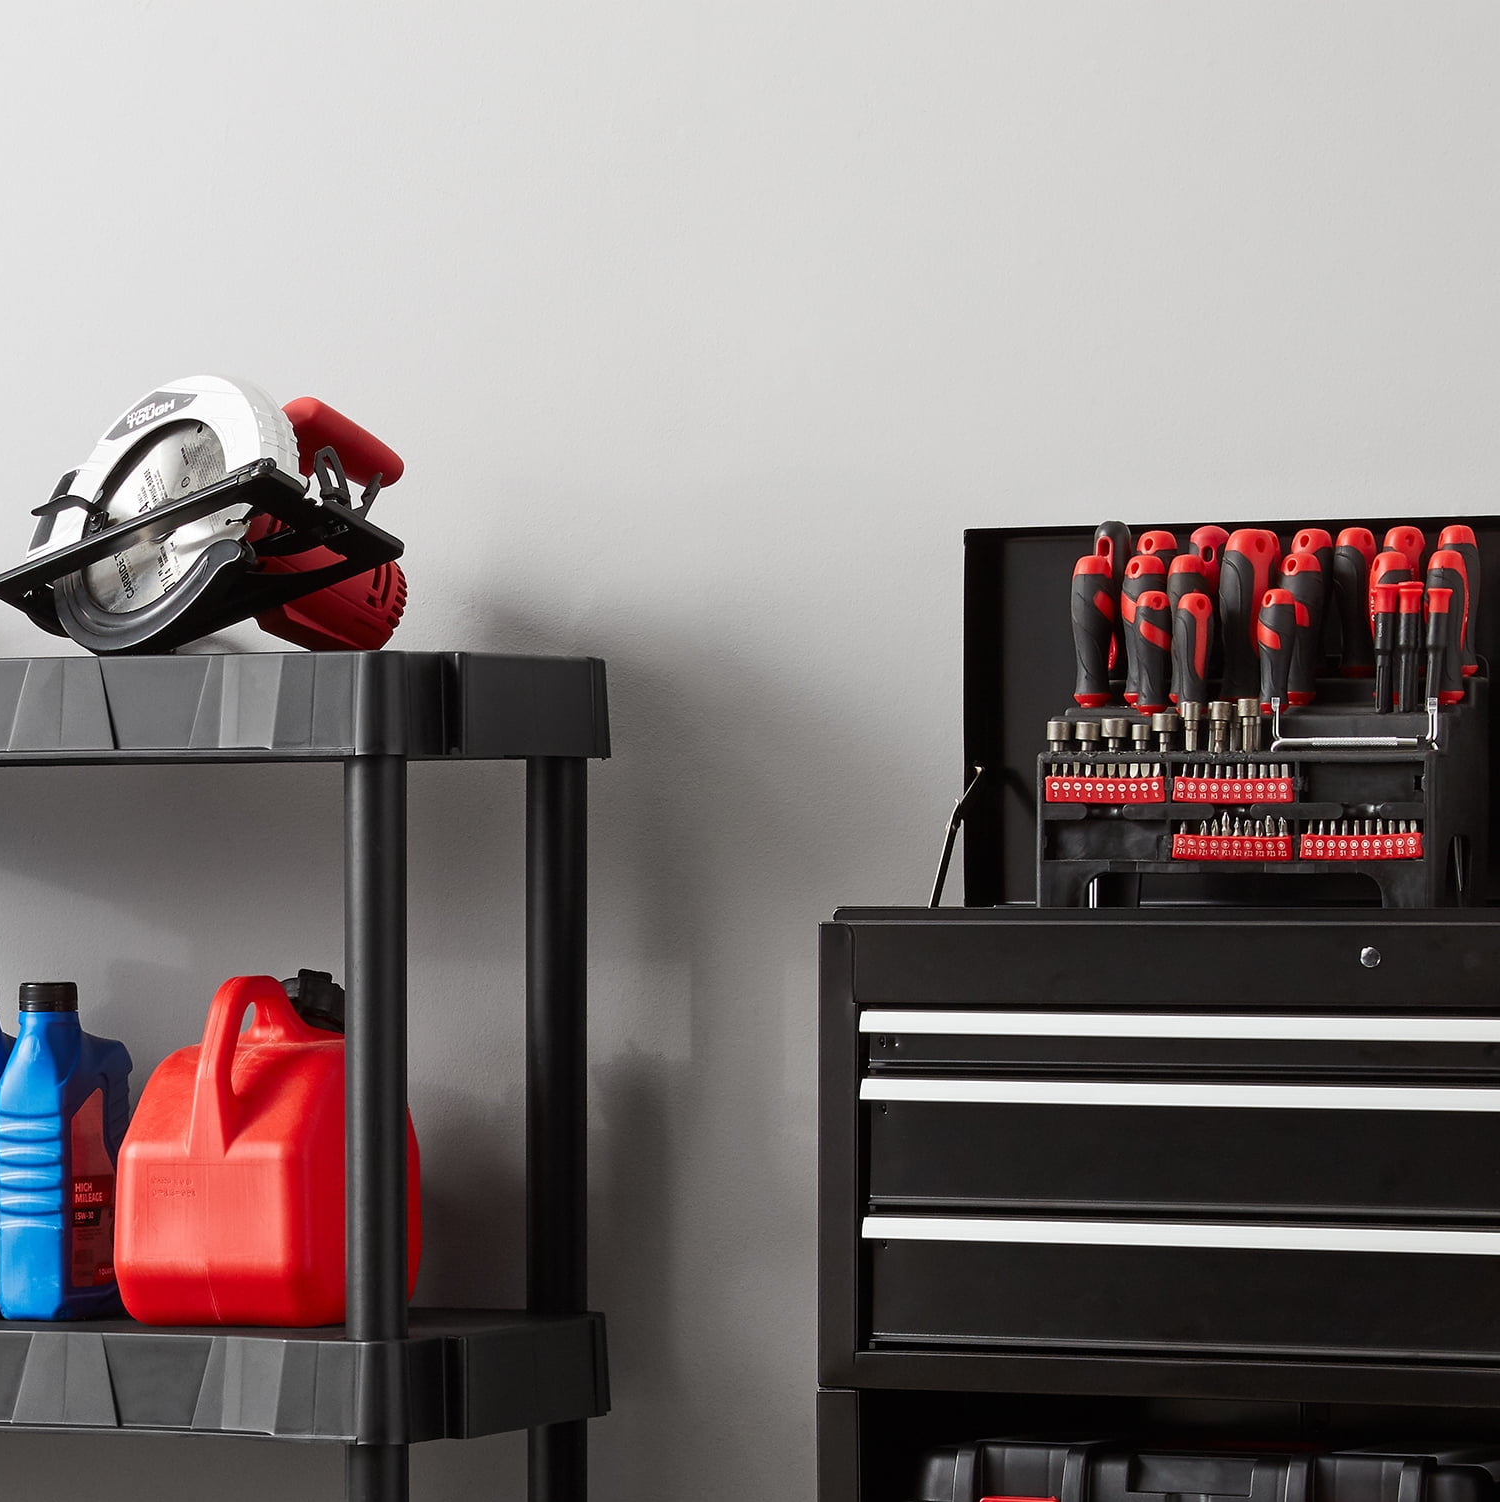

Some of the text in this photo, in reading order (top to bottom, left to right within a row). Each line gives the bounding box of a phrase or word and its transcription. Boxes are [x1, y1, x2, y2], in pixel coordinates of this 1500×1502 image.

[126, 402, 156, 421] HYPER
[126, 398, 176, 429] TOUGH
[115, 558, 135, 599] CARBIDE
[75, 1182, 93, 1192] HIGH
[75, 1192, 103, 1204] MILEAGE
